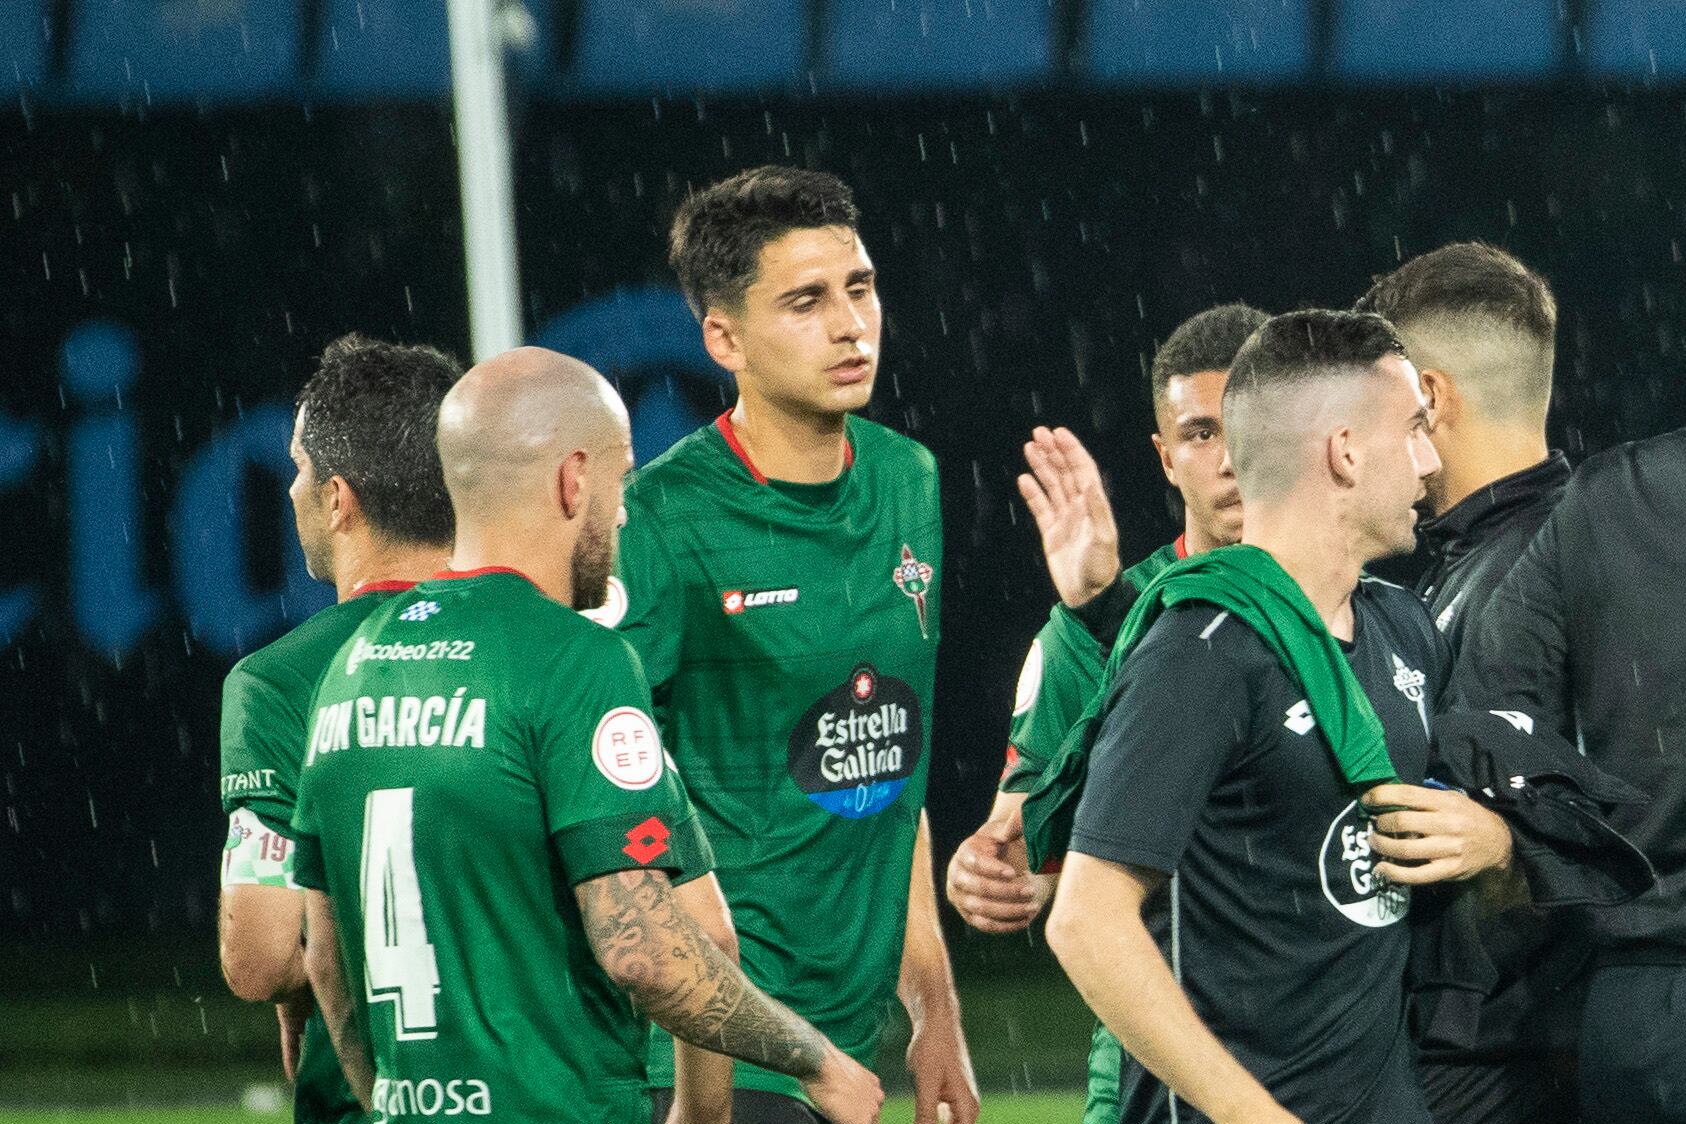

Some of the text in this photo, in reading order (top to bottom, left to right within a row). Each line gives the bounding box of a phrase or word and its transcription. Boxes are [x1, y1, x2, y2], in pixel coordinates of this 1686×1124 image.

[426, 640, 475, 660] 21-22
[356, 687, 486, 748] GARCÍA
[221, 769, 275, 796] ITANT
[259, 832, 287, 862] 19
[359, 787, 440, 1041] 4
